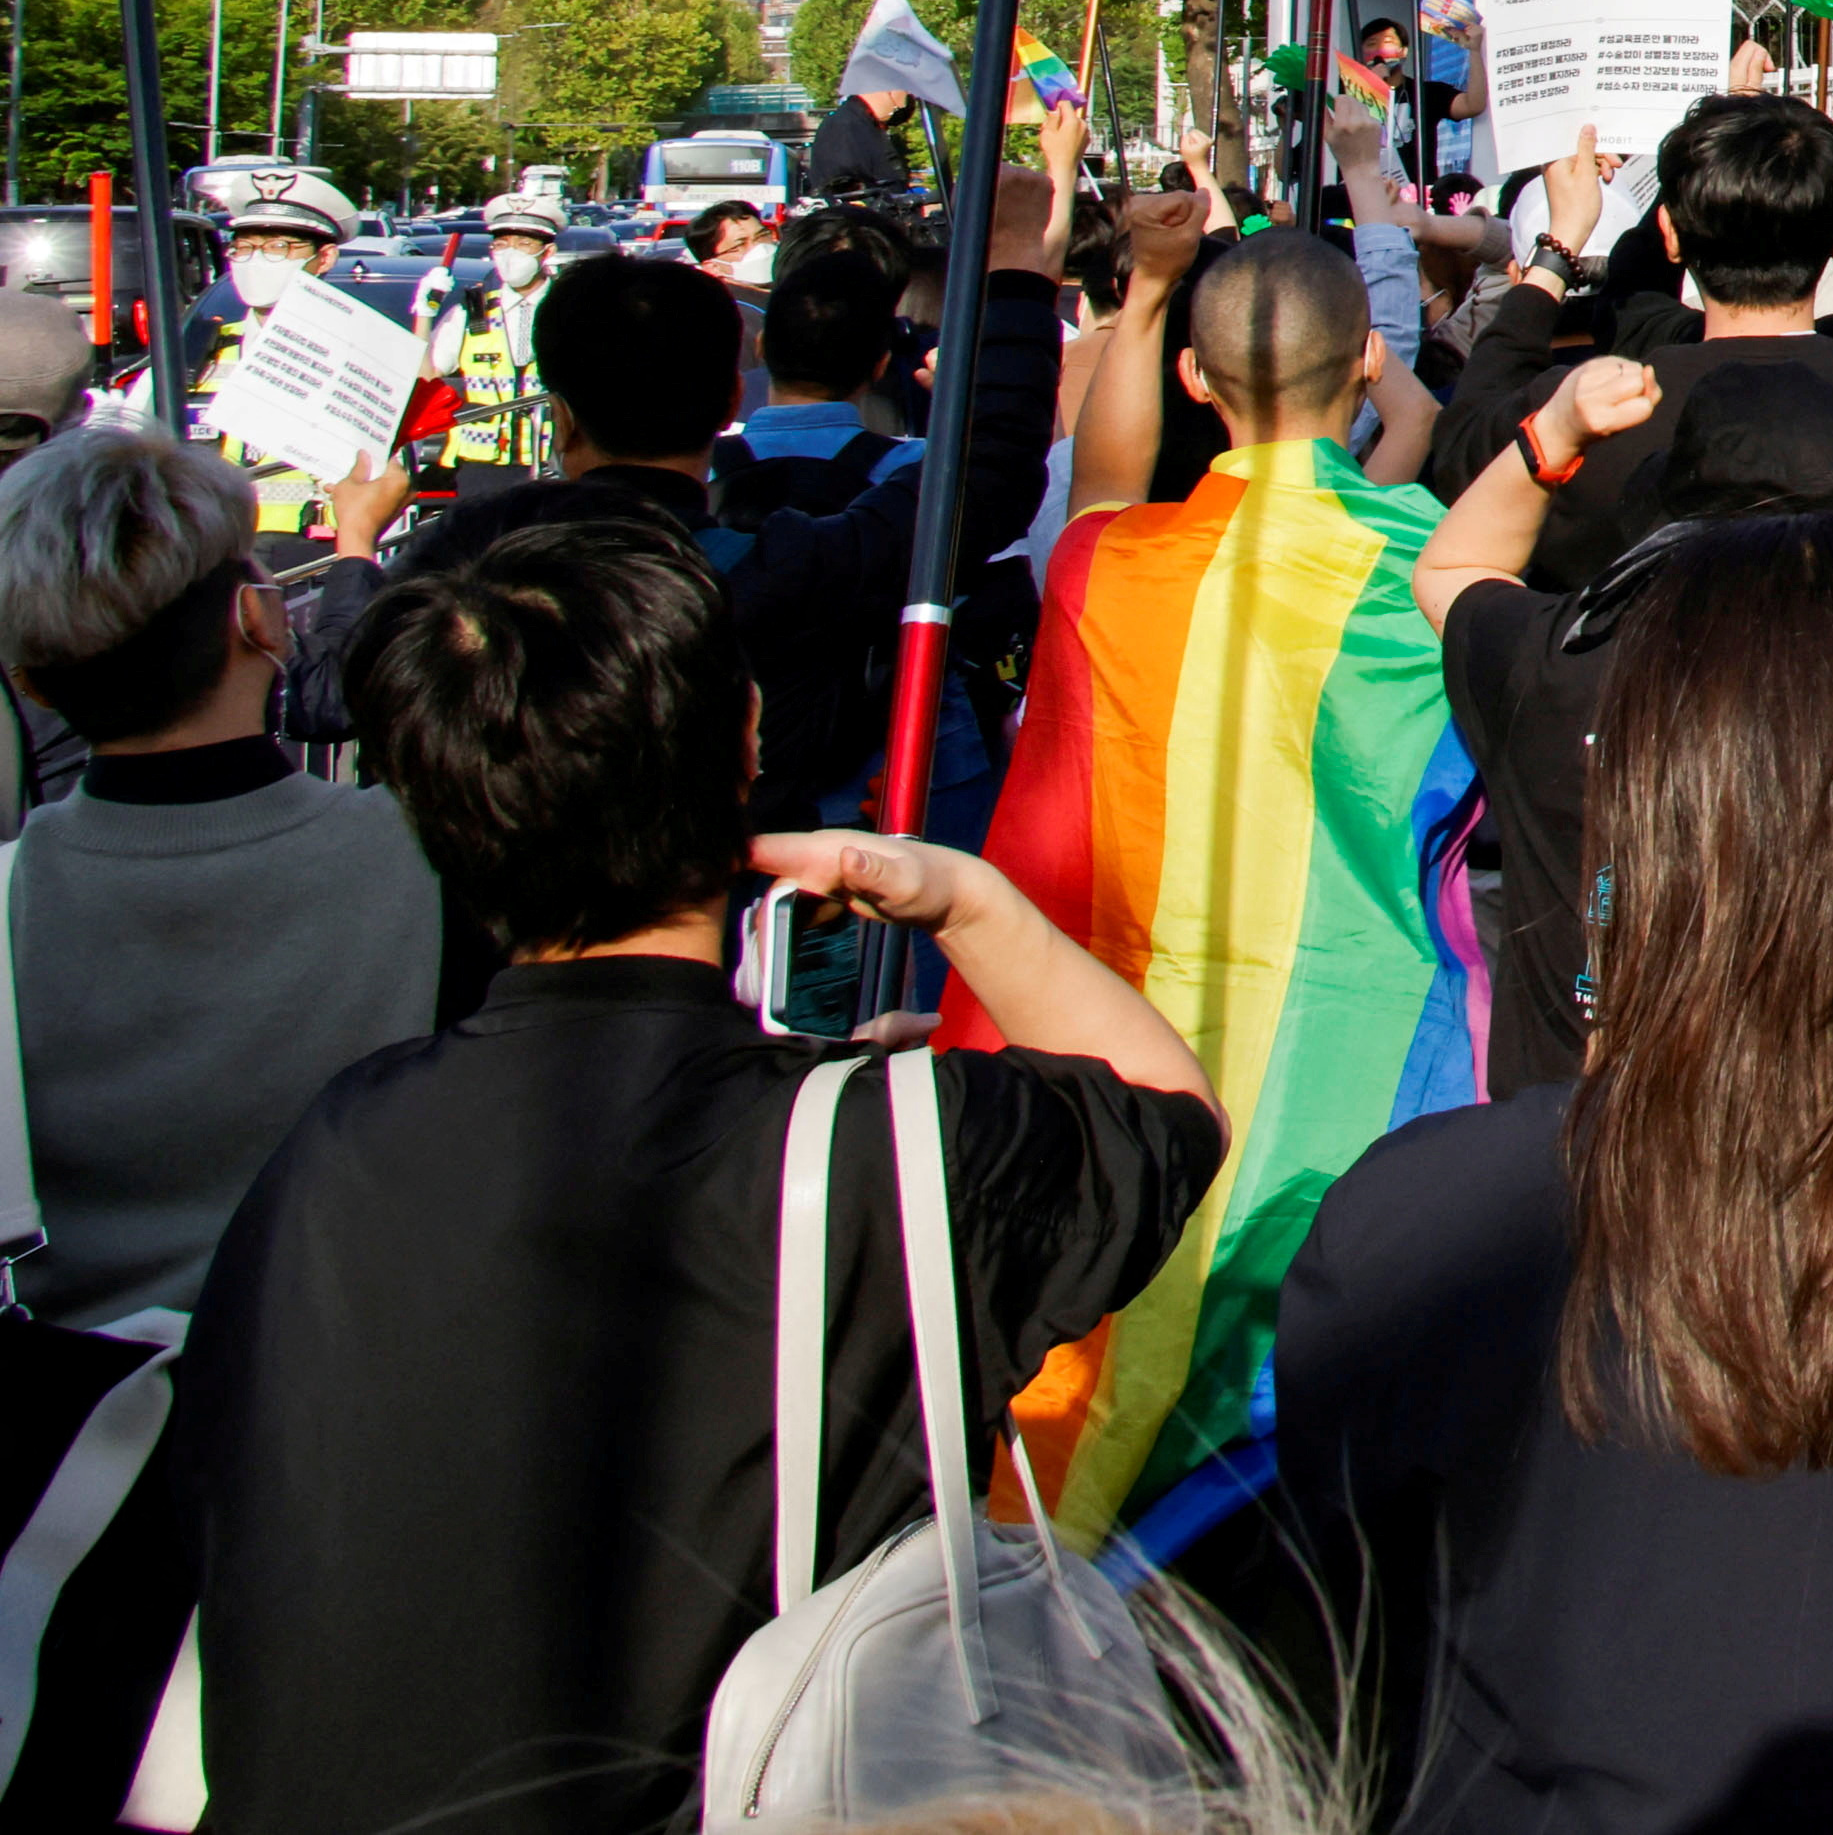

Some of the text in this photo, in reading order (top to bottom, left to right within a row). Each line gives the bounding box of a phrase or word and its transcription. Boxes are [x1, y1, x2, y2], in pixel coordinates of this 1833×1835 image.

[1599, 33, 1700, 45] #성교육표준안 폐기하라
[1496, 37, 1572, 59] #차별금지법 제정하라
[1554, 51, 1588, 65] 폐지하라
[1598, 50, 1719, 62] #수술없이 성별정정 보장하라
[1548, 68, 1581, 83] 폐지하라
[1597, 65, 1718, 78] #트랜지션 건강보험 보장하라
[1539, 85, 1570, 100] 보장하라
[1596, 81, 1718, 94] #성소수자 인권교육 실시하라
